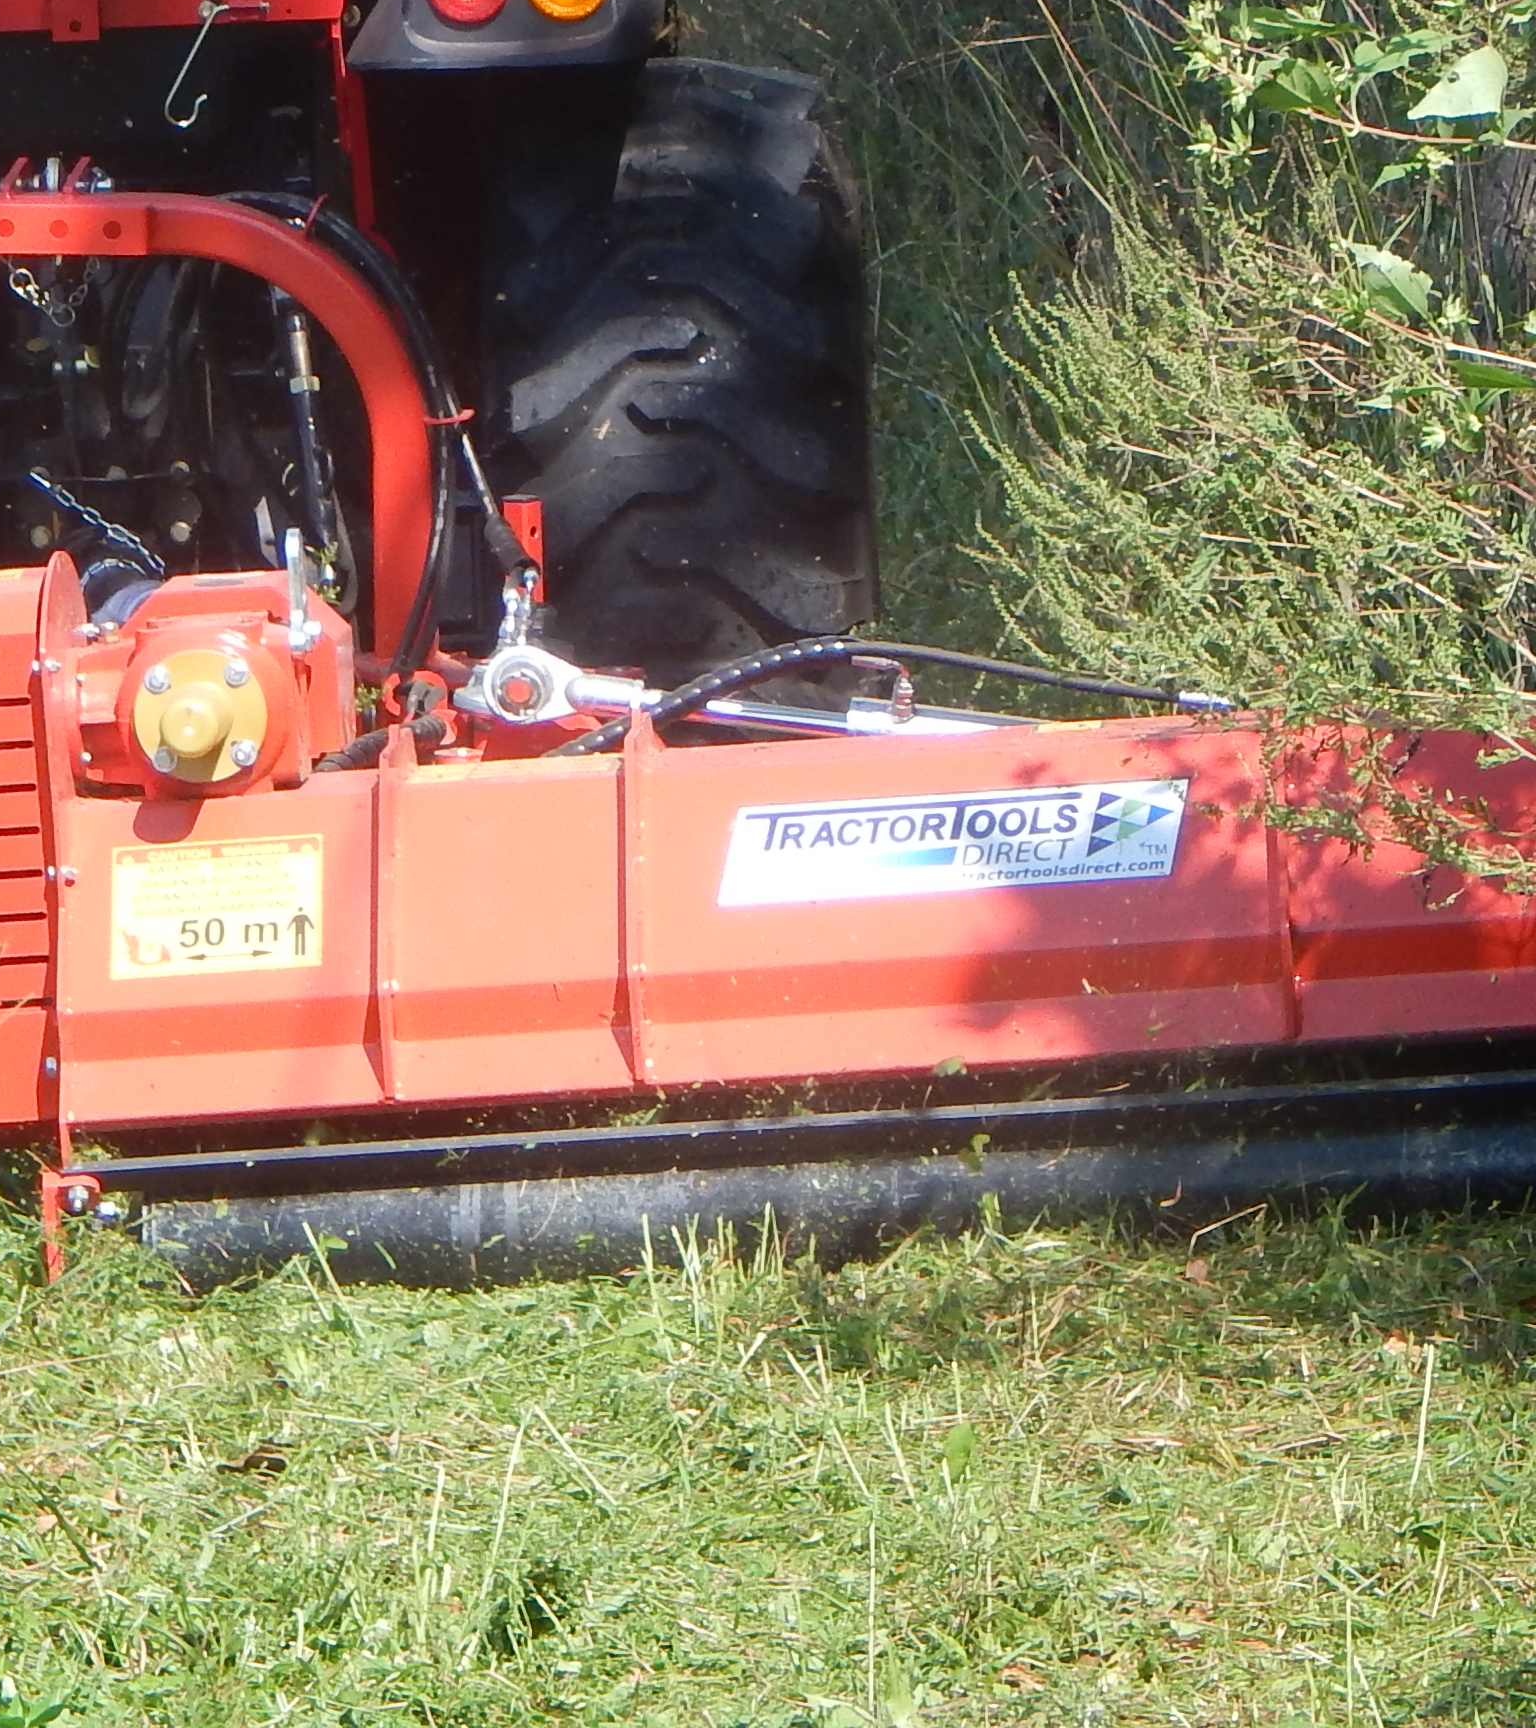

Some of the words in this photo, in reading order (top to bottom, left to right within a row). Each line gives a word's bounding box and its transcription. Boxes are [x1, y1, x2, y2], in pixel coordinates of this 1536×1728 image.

[147, 848, 212, 863] CAUTION
[962, 837, 1075, 866] DIRECT
[962, 860, 1166, 881] ractortoolsdirect.com
[179, 917, 226, 949] 50
[243, 921, 279, 944] m
